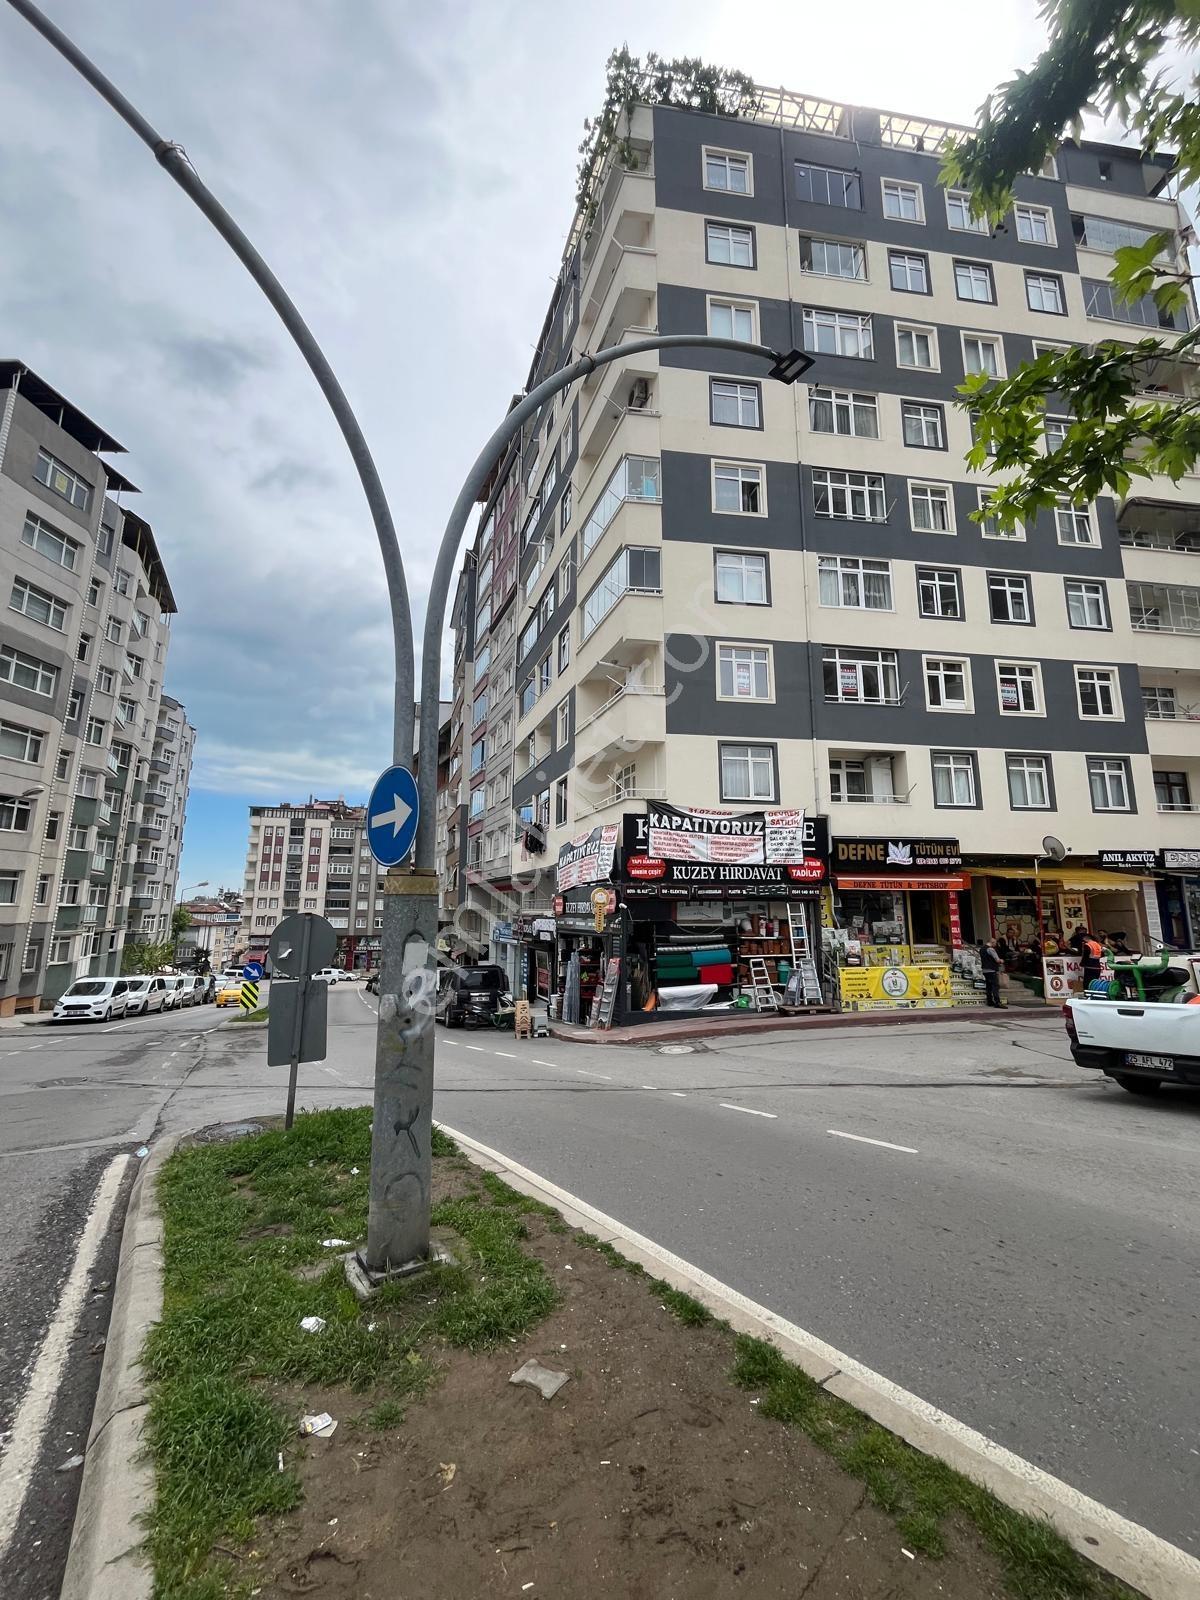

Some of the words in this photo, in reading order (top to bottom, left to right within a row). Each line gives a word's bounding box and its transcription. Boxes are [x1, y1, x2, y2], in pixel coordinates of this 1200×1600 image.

[649, 813, 764, 836] KAPATIYORUZ
[770, 818, 799, 826] SATILIK
[838, 844, 885, 861] DEFNE
[914, 842, 944, 856] TÜTÜN
[946, 842, 961, 856] EVİ
[1102, 853, 1124, 862] ANIL
[1126, 851, 1155, 862] AKYÜZ
[672, 866, 717, 880] KUZEY
[791, 868, 821, 877] TADİLAT
[853, 881, 876, 889] DEFNE
[880, 880, 903, 889] TÜTÜN
